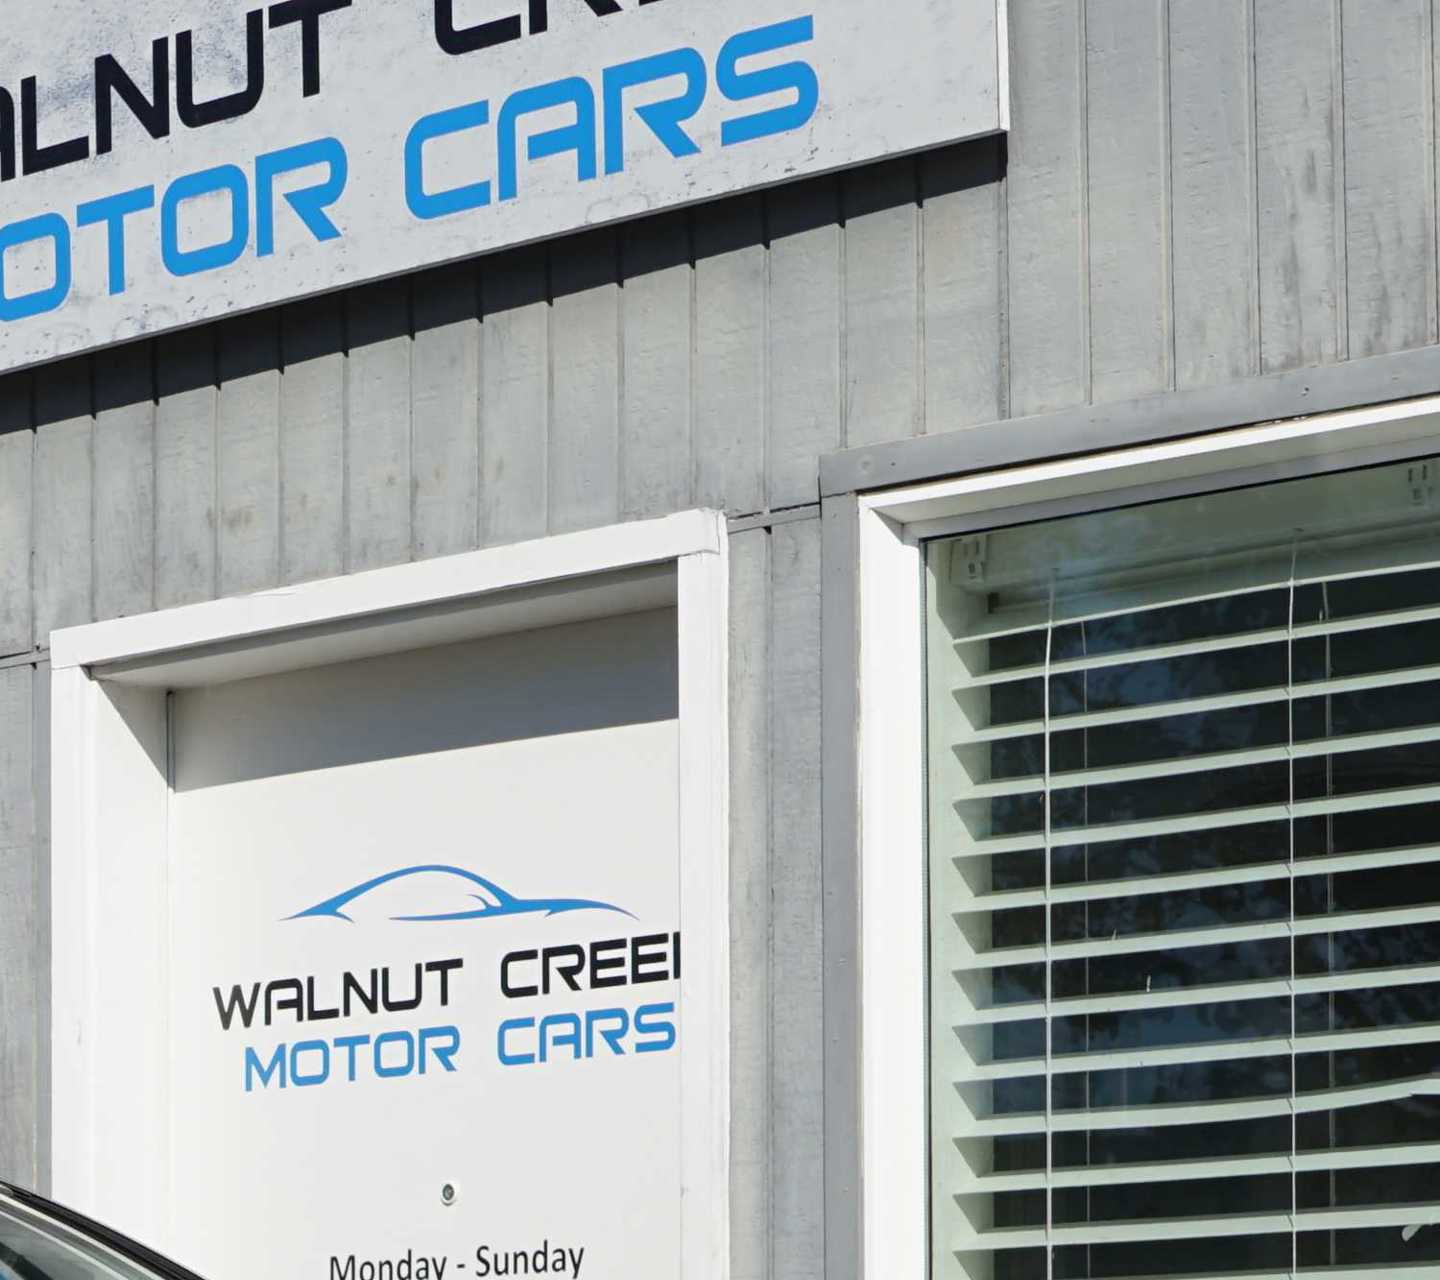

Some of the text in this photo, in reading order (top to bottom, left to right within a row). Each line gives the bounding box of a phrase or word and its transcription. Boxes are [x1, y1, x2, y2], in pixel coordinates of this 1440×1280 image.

[402, 15, 821, 221] CARS
[213, 958, 464, 1030] WALNUT
[243, 1001, 677, 1091] MOTOR CARS
[476, 1239, 585, 1280] Sunday
